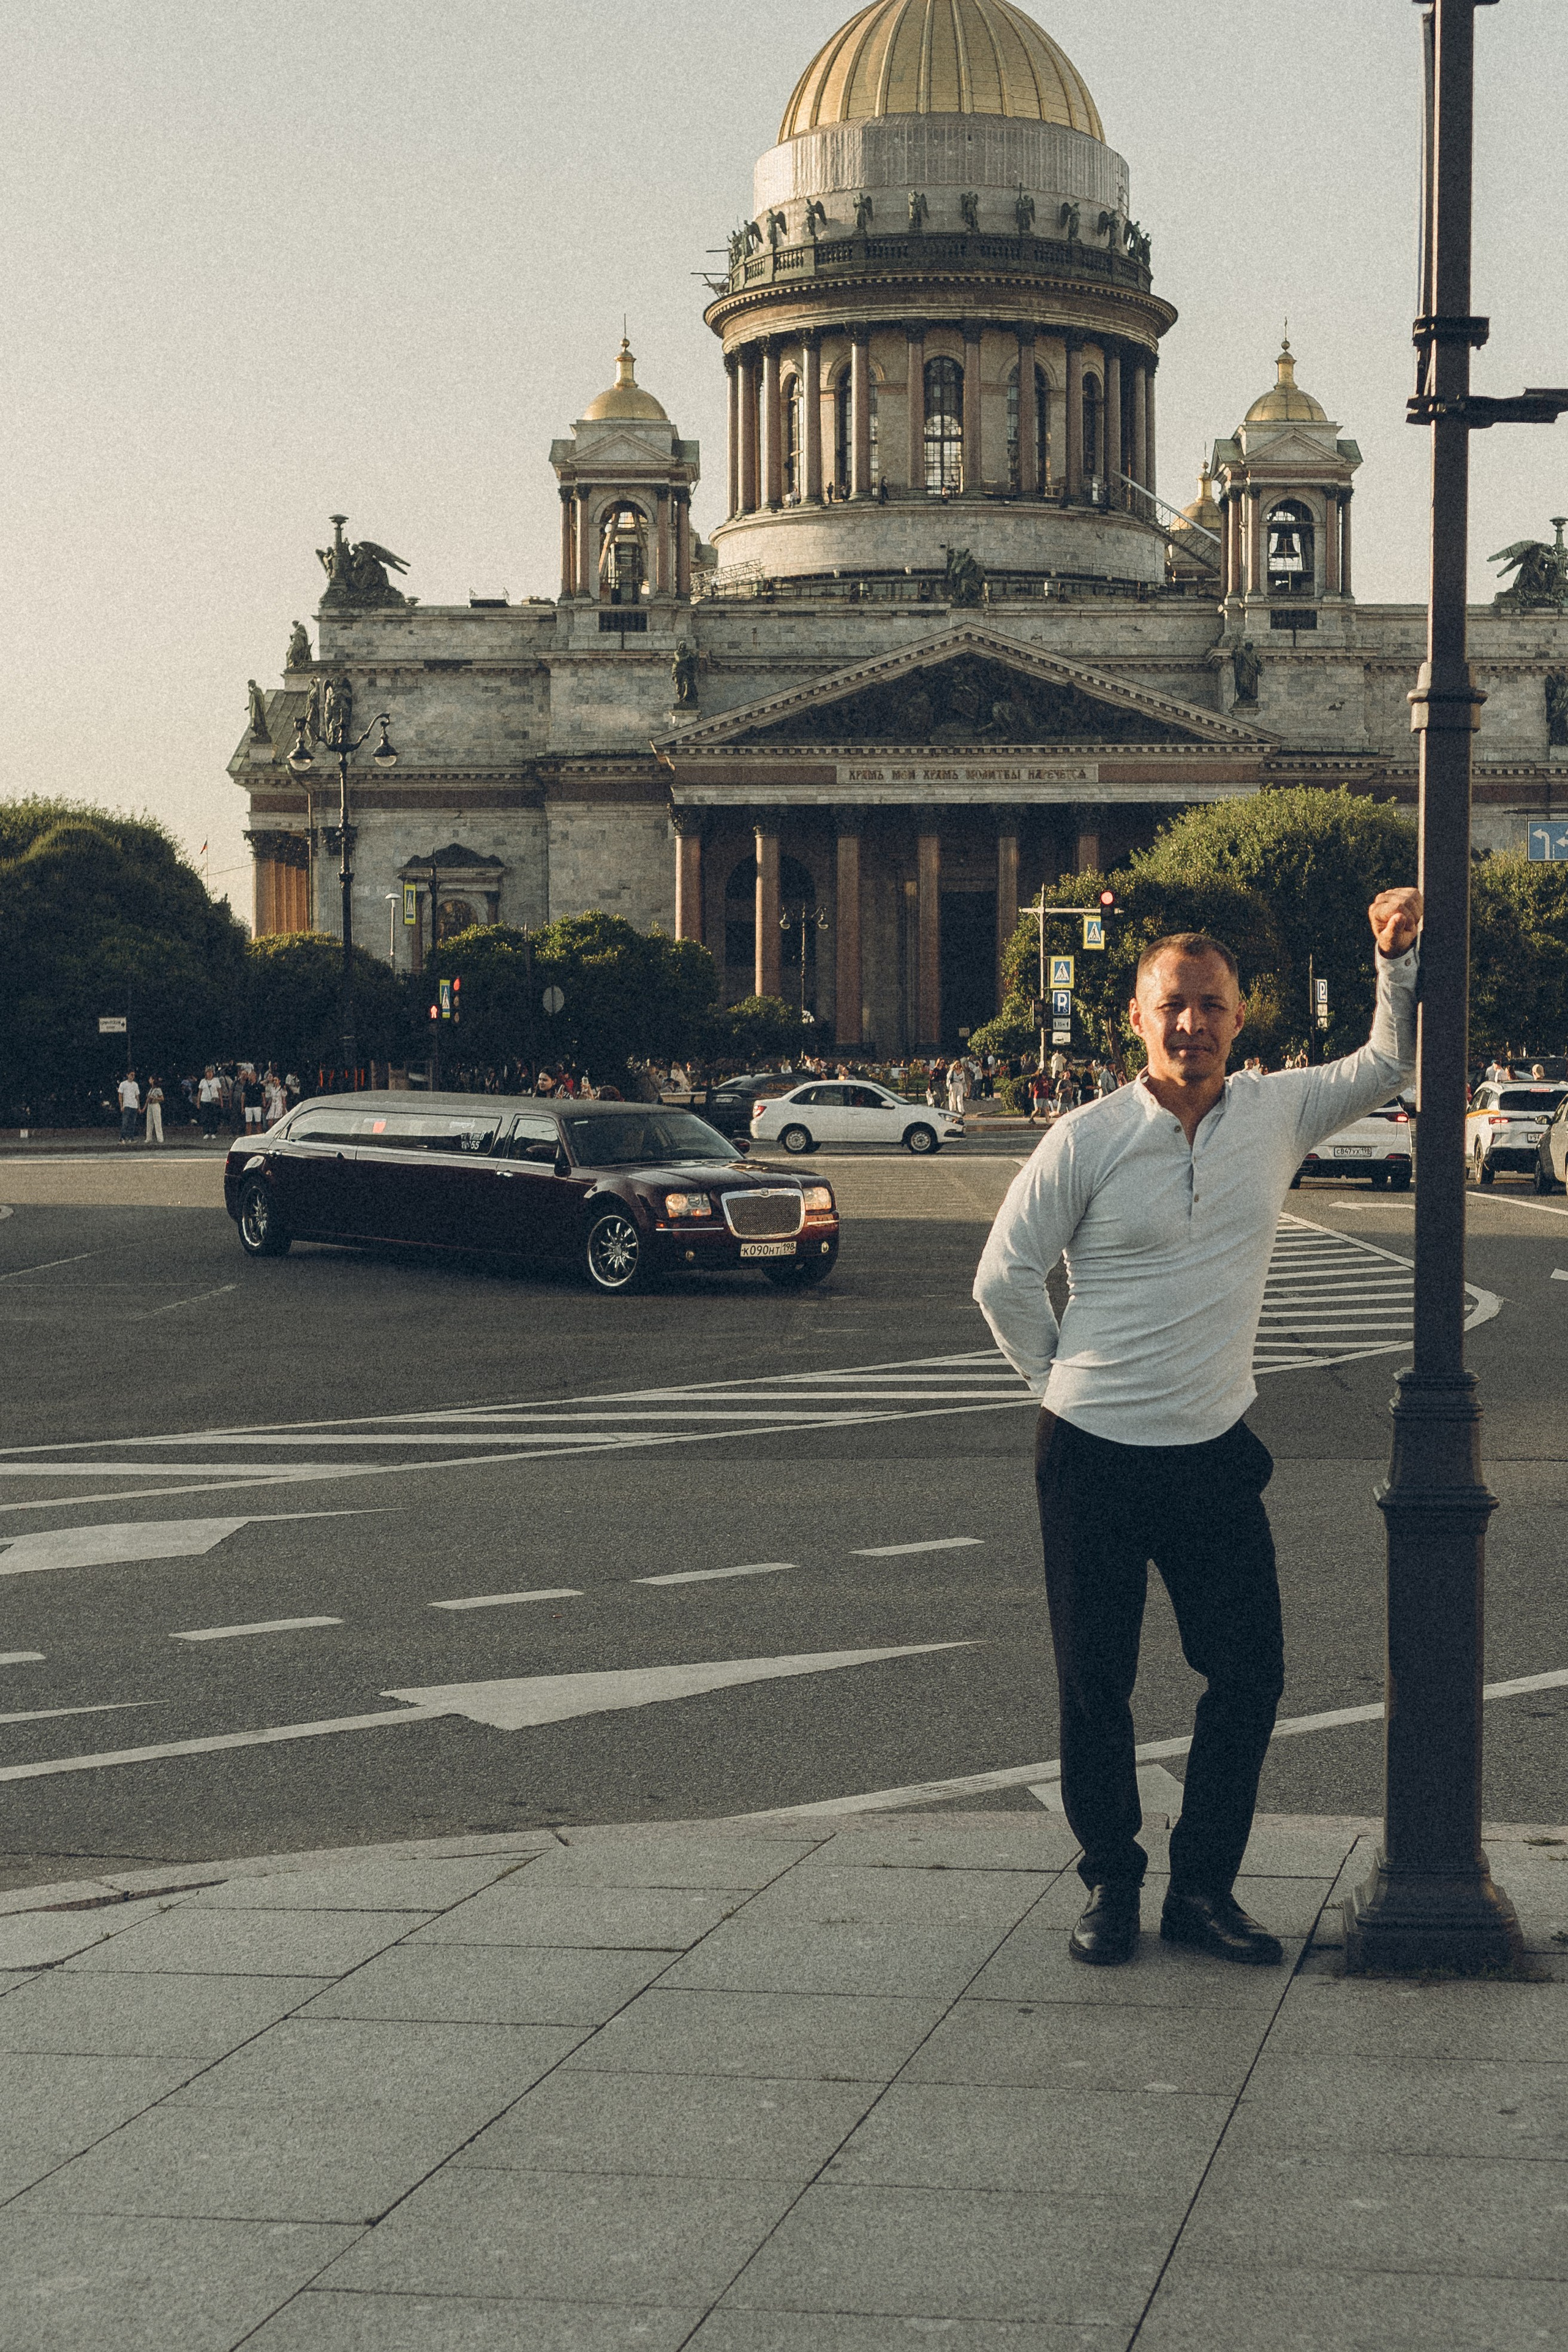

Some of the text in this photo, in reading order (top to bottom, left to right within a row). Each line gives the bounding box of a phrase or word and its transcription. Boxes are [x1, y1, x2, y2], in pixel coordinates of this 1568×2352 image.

[849, 769, 884, 780] ХРАМЪ
[923, 769, 959, 780] ХРАМЪ
[1057, 993, 1068, 1012] P
[782, 1242, 795, 1251] 198
